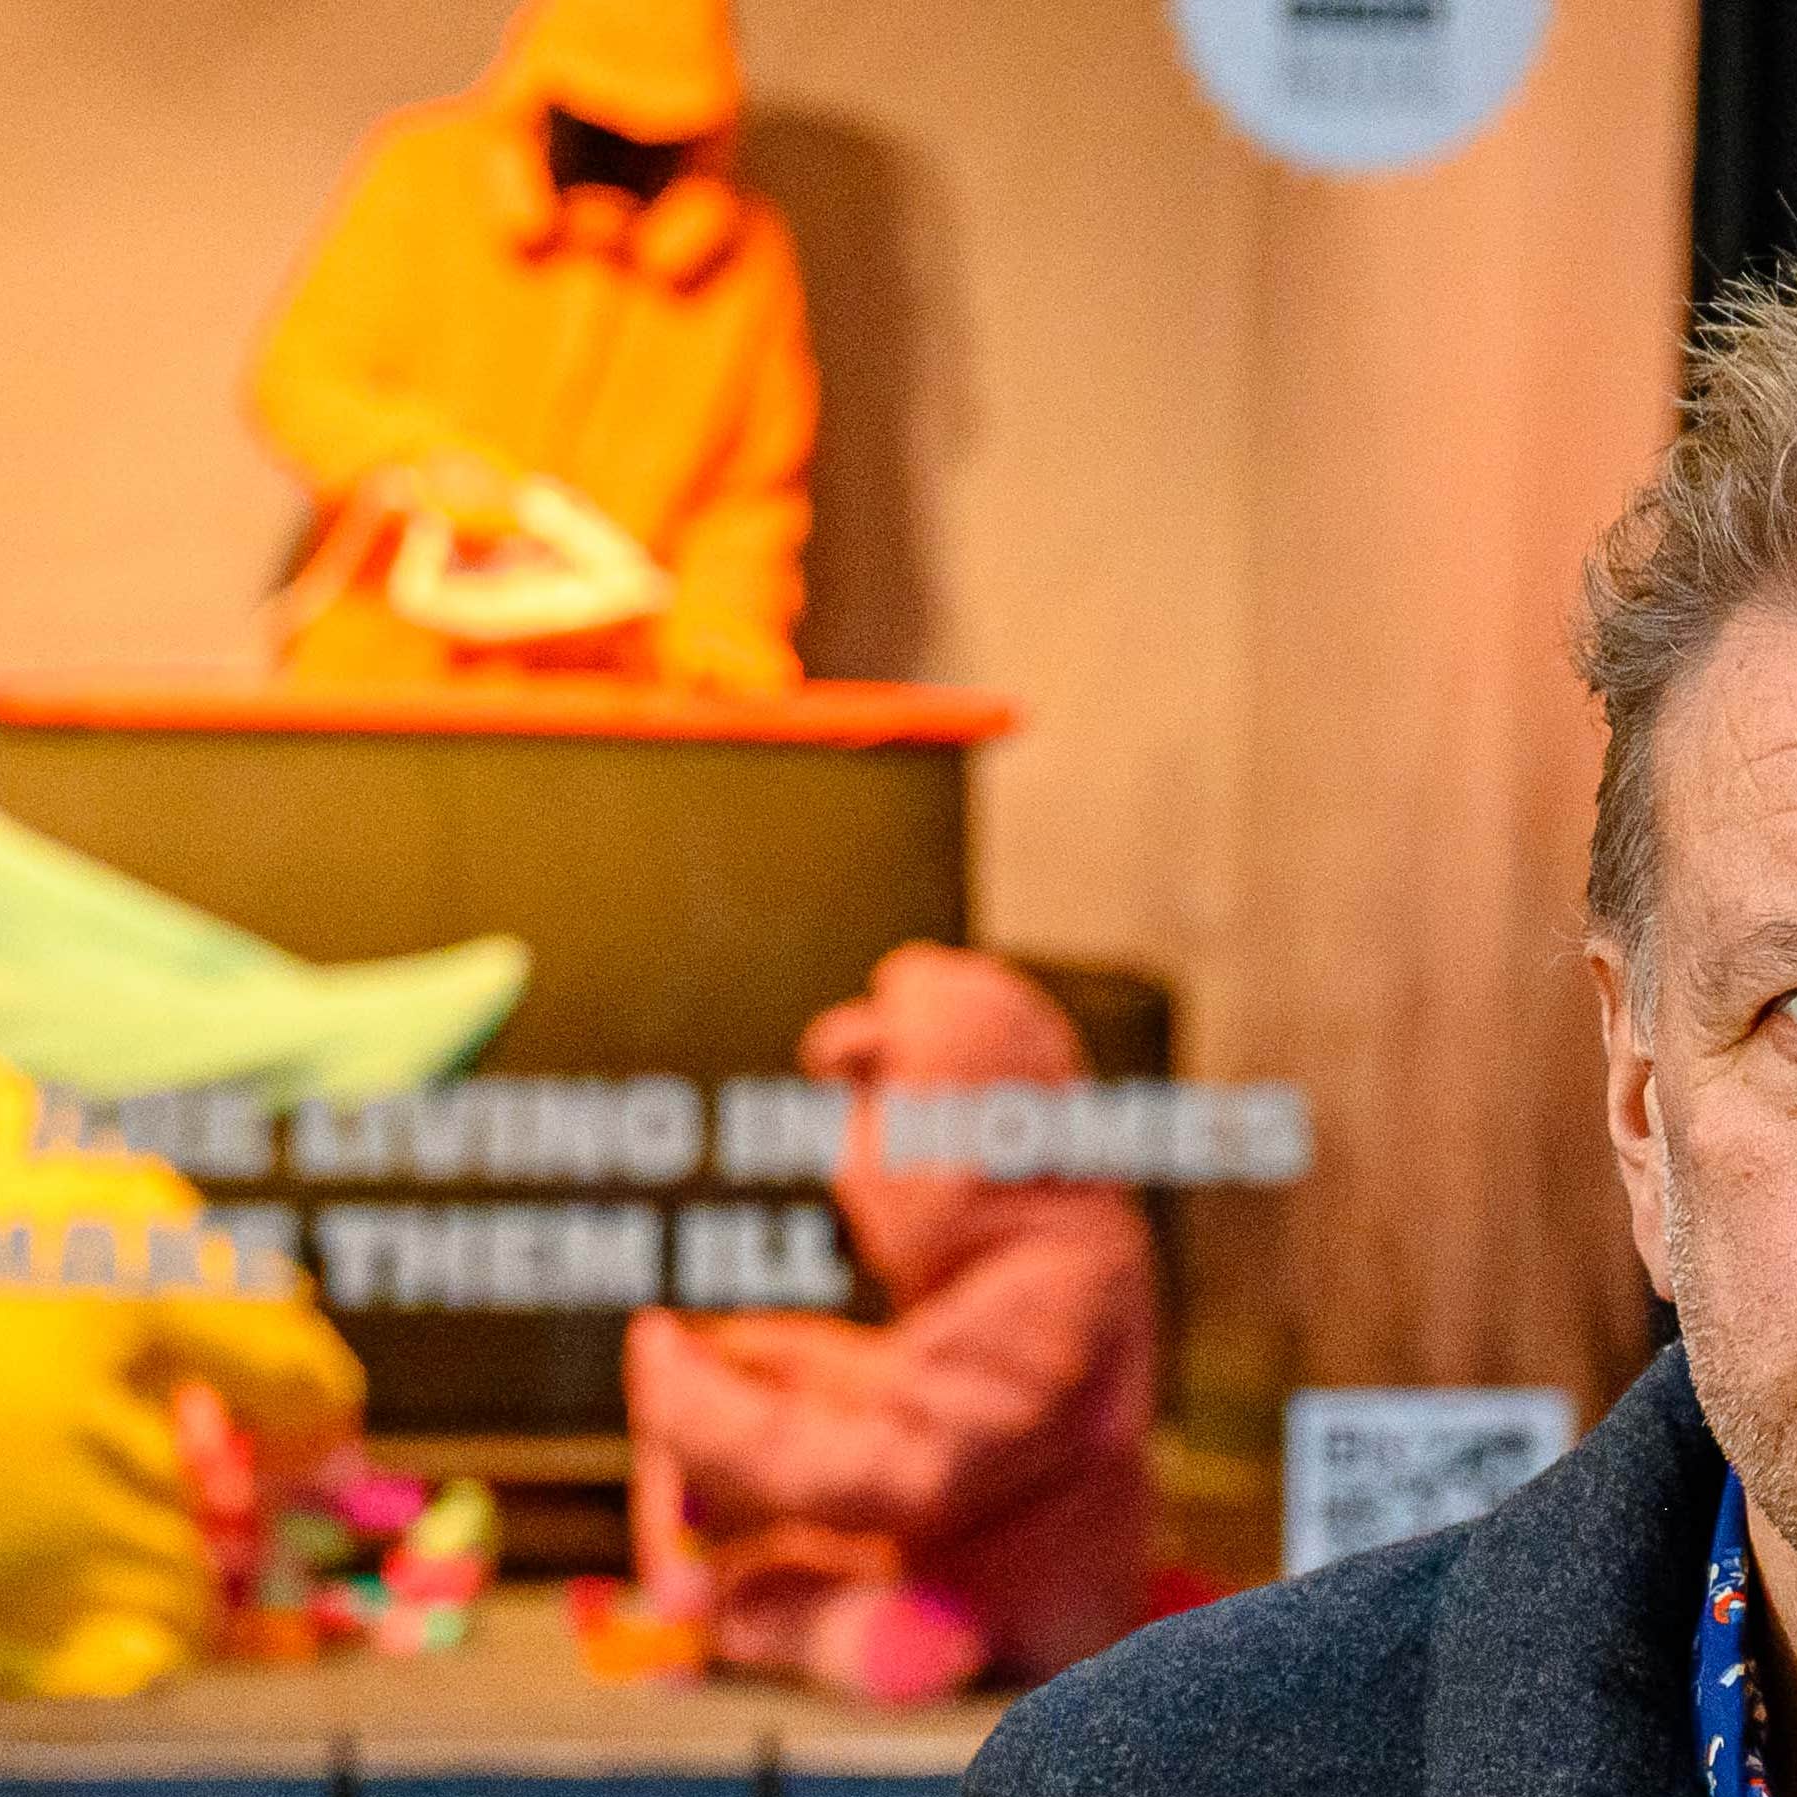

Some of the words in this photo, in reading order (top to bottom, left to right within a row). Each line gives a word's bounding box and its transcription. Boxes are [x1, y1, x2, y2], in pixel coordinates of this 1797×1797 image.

[27, 1078, 272, 1176] ARE
[291, 1078, 703, 1180] LIVING
[717, 1078, 861, 1180] IN
[875, 1078, 1315, 1183] HOMES
[317, 1204, 663, 1306] THEM
[675, 1204, 852, 1308] ILL
